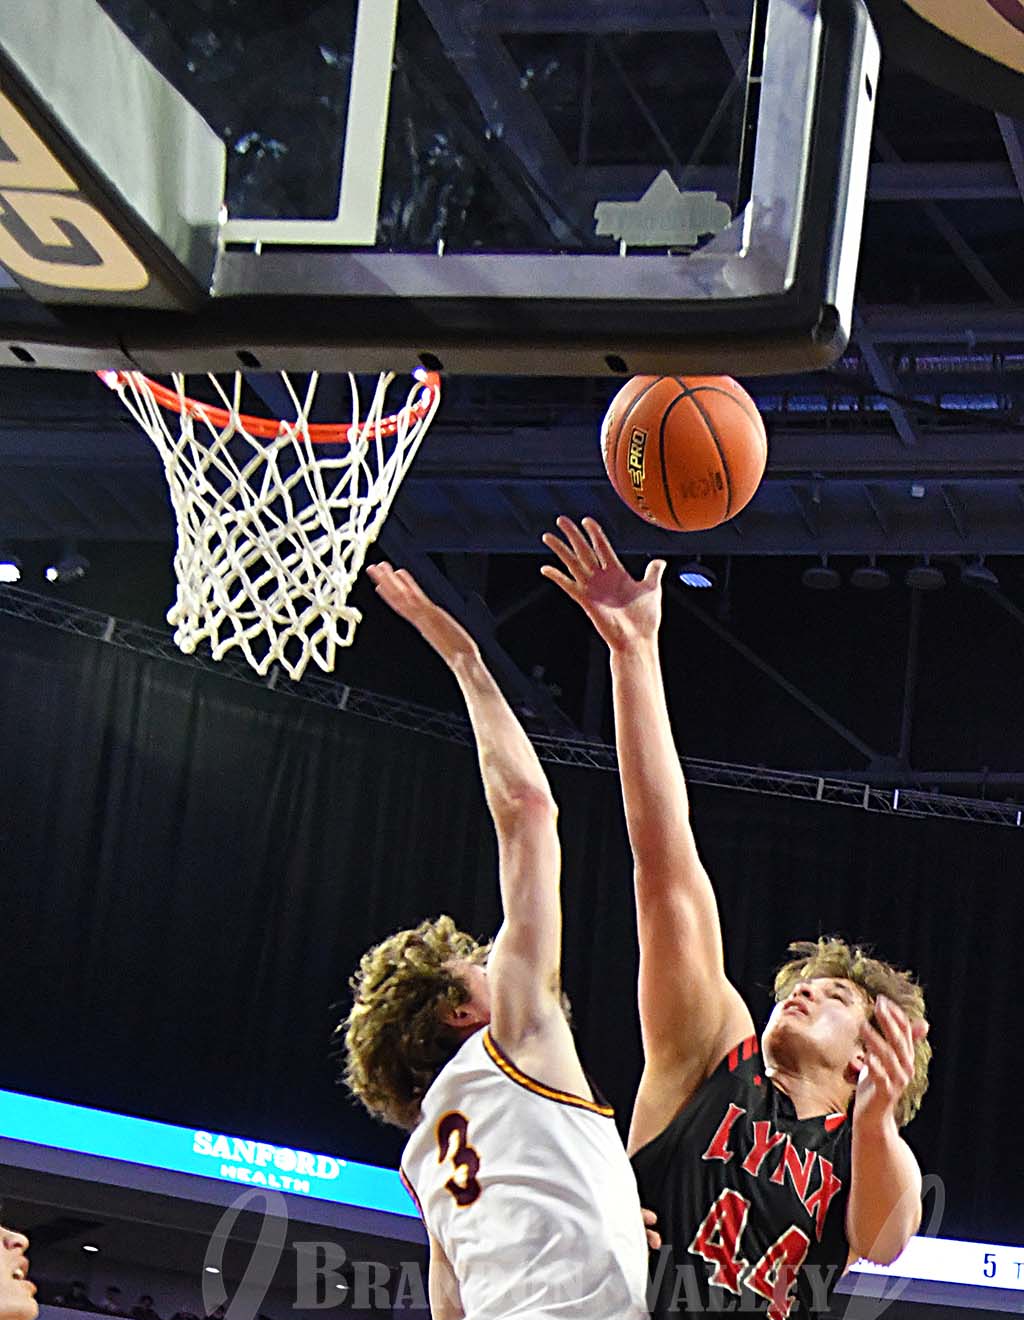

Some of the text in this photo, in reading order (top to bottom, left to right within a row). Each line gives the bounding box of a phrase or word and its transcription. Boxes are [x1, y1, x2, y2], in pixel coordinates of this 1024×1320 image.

[193, 1130, 342, 1180] SANFORD
[220, 1163, 310, 1193] HEALTH
[437, 1110, 482, 1208] 3
[702, 1102, 842, 1242] LYNX
[983, 1253, 997, 1278] 5
